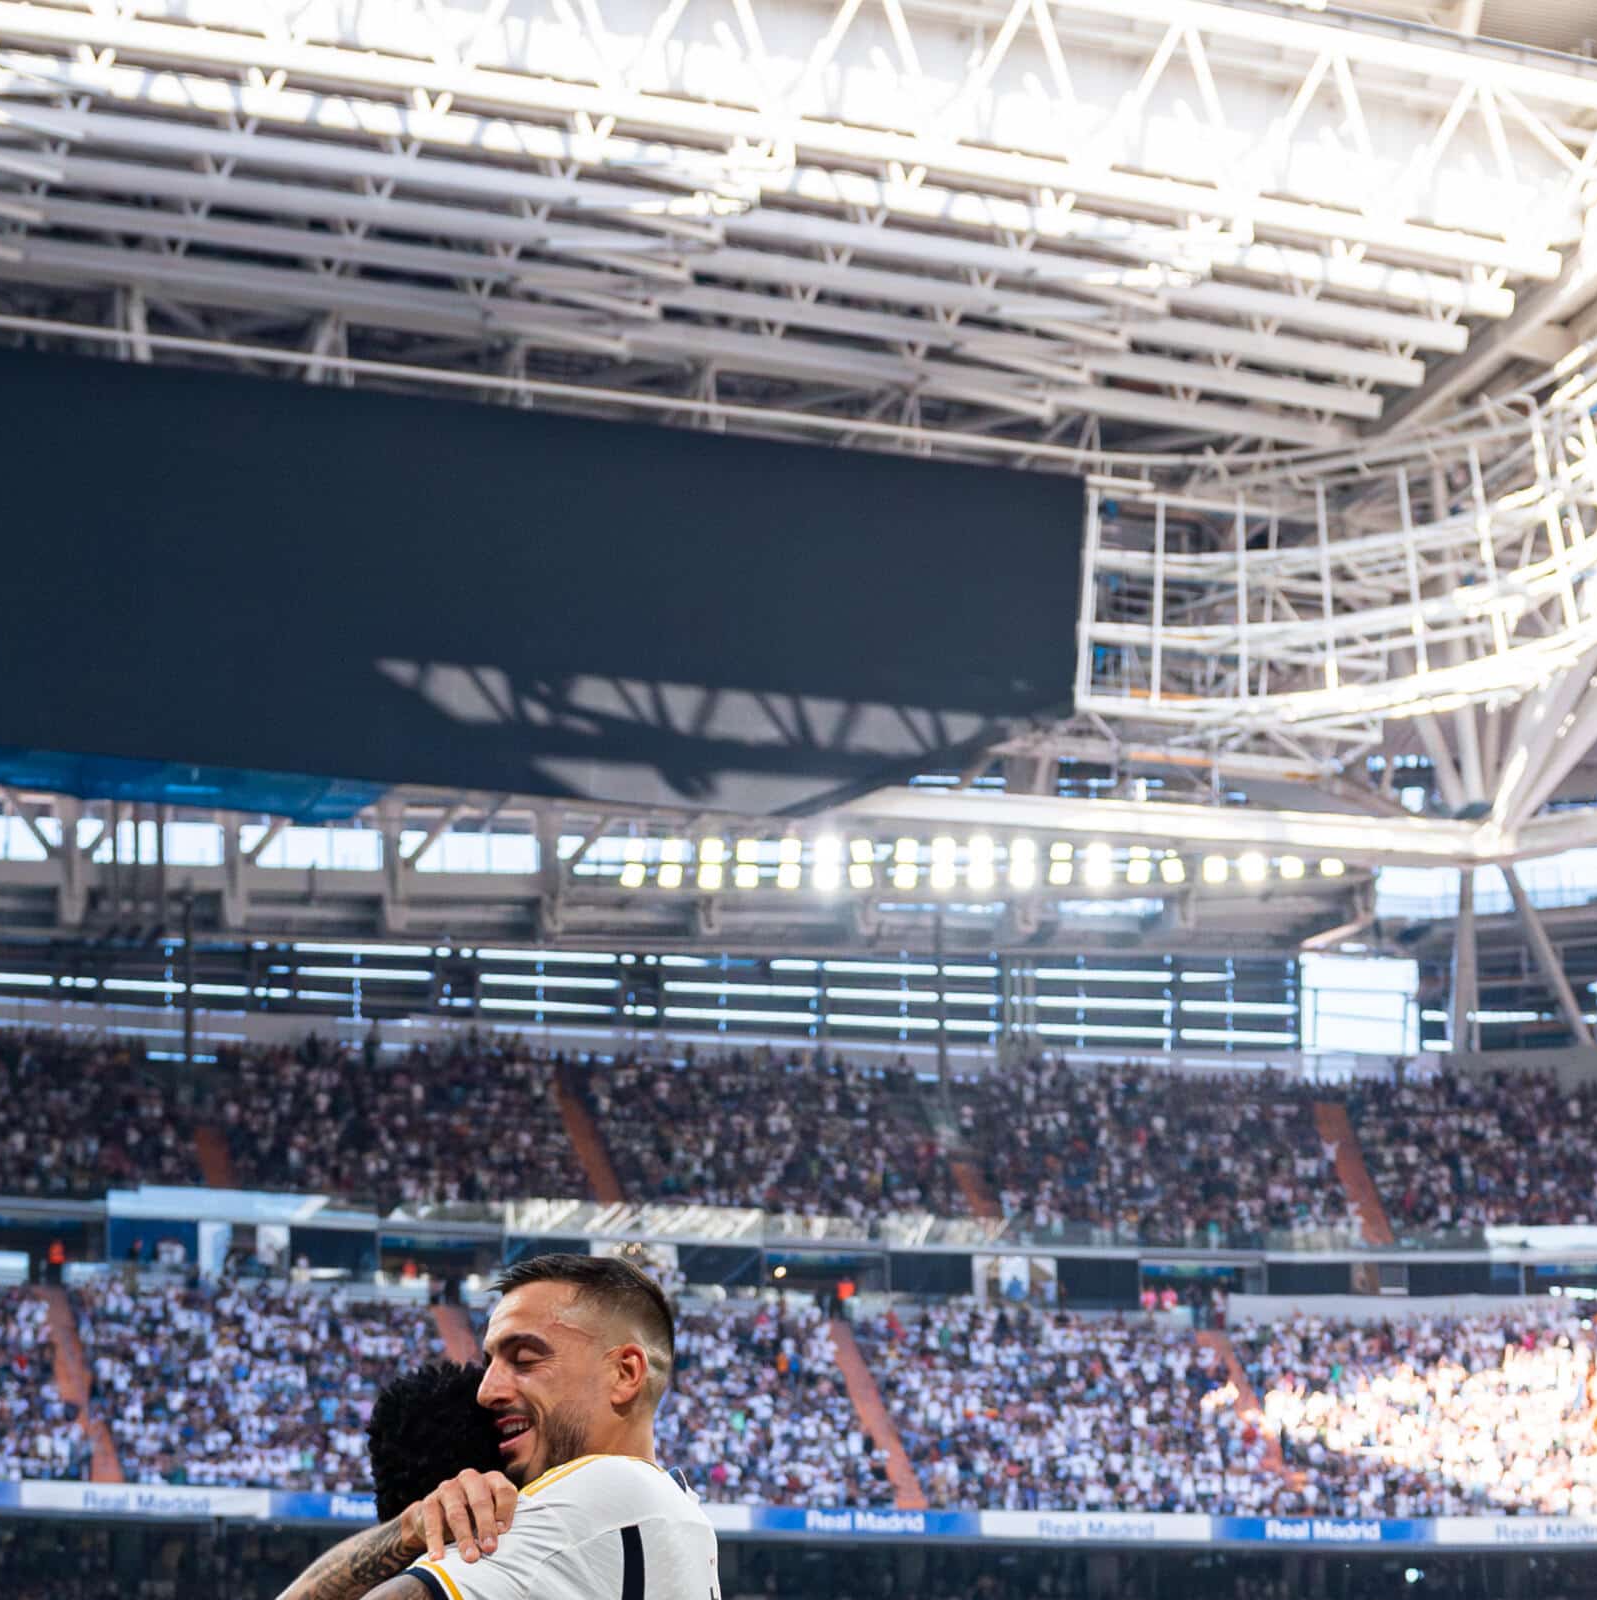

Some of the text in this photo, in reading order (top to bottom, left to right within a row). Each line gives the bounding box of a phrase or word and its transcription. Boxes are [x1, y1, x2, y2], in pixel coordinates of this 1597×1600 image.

[806, 1509, 926, 1533] Real Madrid
[1038, 1518, 1156, 1540] Real Madrid
[1265, 1520, 1381, 1541] Real Madrid
